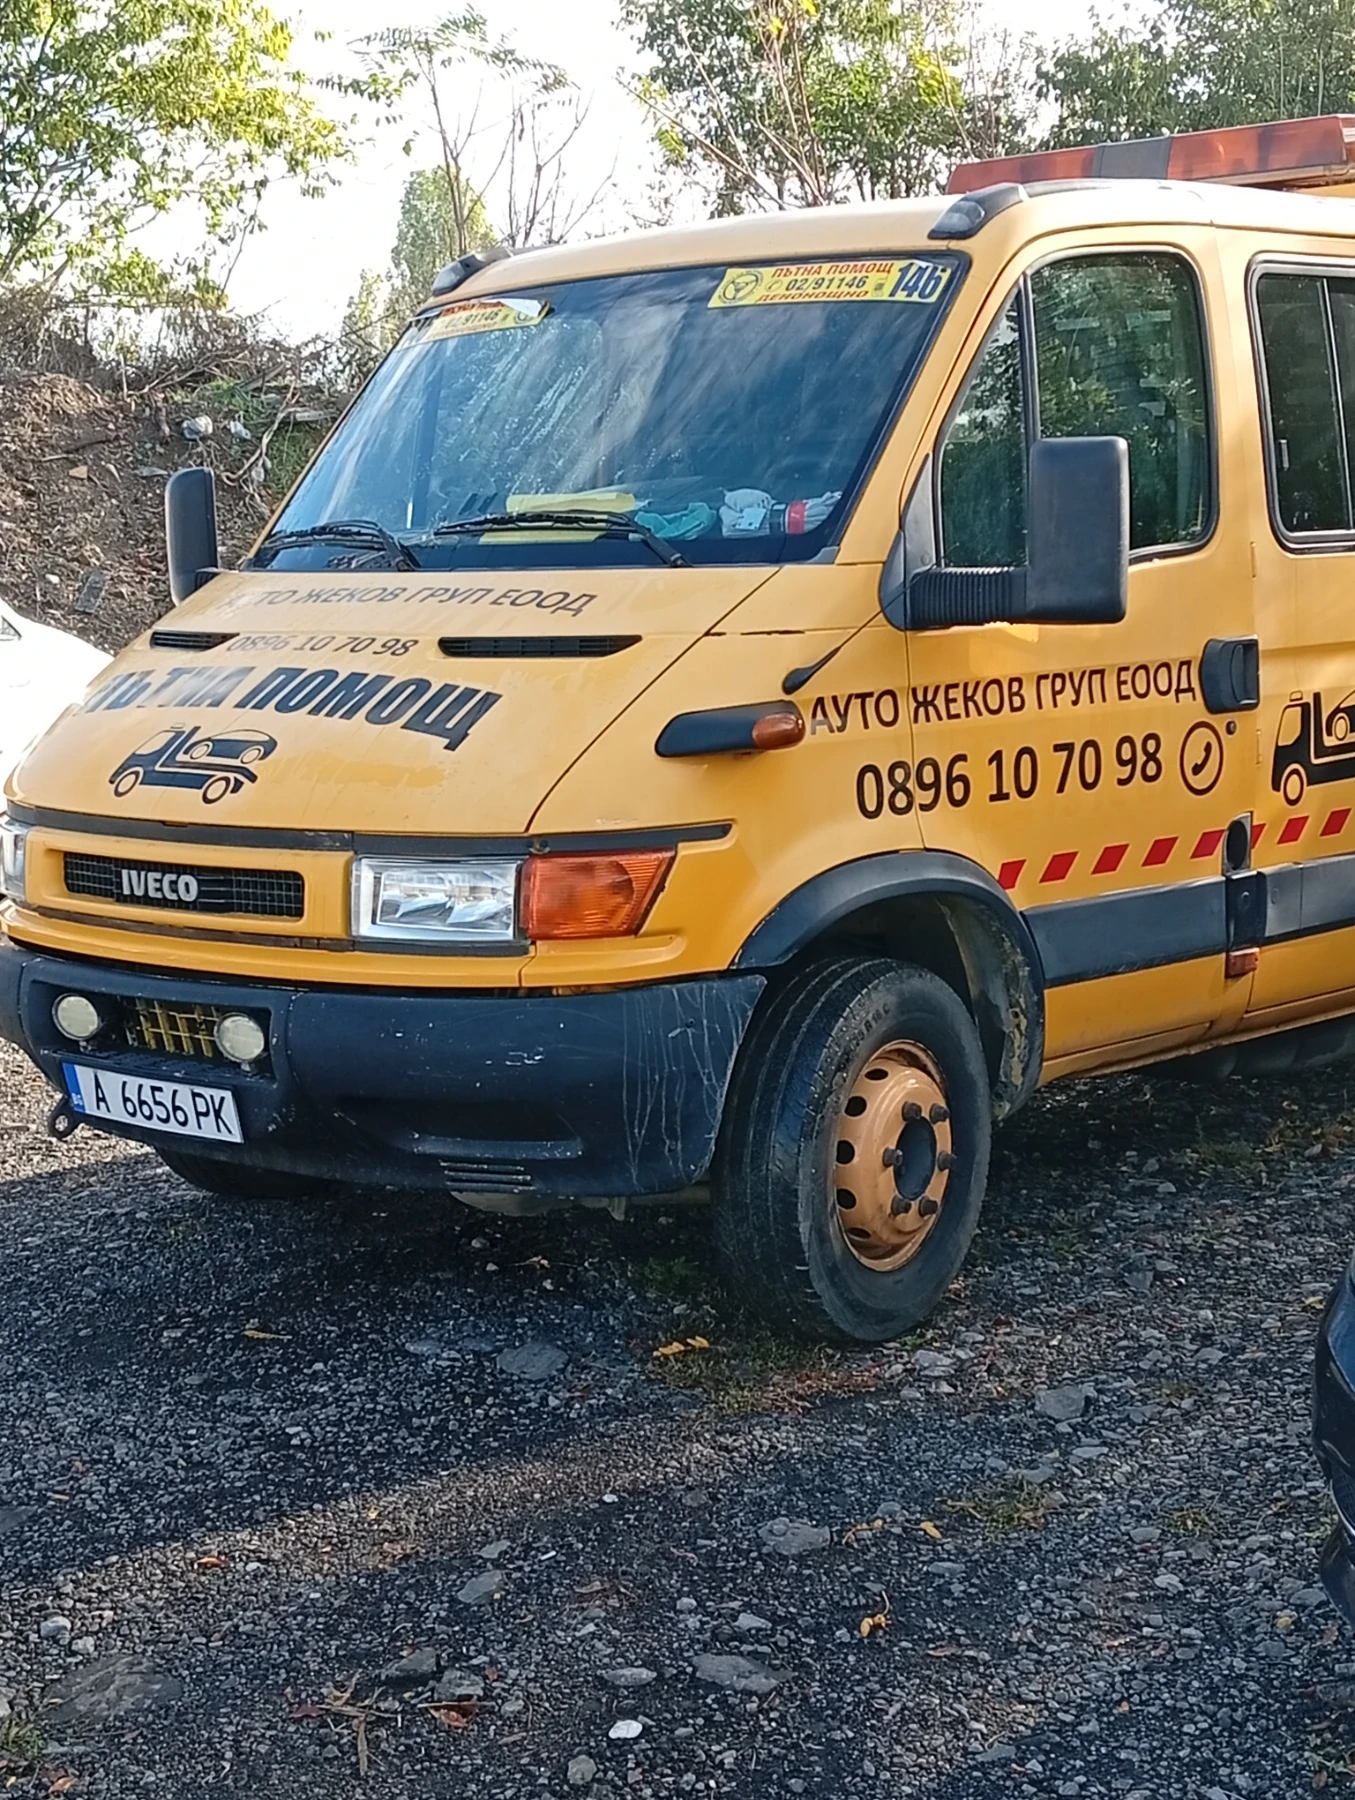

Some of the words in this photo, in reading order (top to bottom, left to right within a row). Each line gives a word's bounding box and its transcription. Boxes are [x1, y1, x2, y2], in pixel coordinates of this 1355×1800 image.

[771, 265, 823, 278] ПЪТНА
[827, 262, 895, 275] ПОМОЩ
[785, 276, 869, 292] 02/91146
[888, 262, 947, 300] 146
[293, 587, 407, 603] ЖЕКОВ
[404, 587, 490, 605] ГРУП
[486, 588, 598, 617] ЕООД
[226, 635, 299, 652] 0896
[293, 635, 336, 651] 10
[333, 636, 378, 653] 70
[372, 638, 420, 657] 98
[232, 667, 504, 752] ПОМОЩ
[810, 688, 900, 735] АУТО
[911, 675, 1026, 724] ЖЕКОВ
[1035, 667, 1108, 710] ГРУП
[1116, 659, 1197, 703] ЕООД
[856, 752, 972, 820] 0896
[986, 745, 1039, 803] 10
[1052, 738, 1103, 795] 70
[1115, 732, 1164, 787] 98
[121, 868, 199, 902] IVECO
